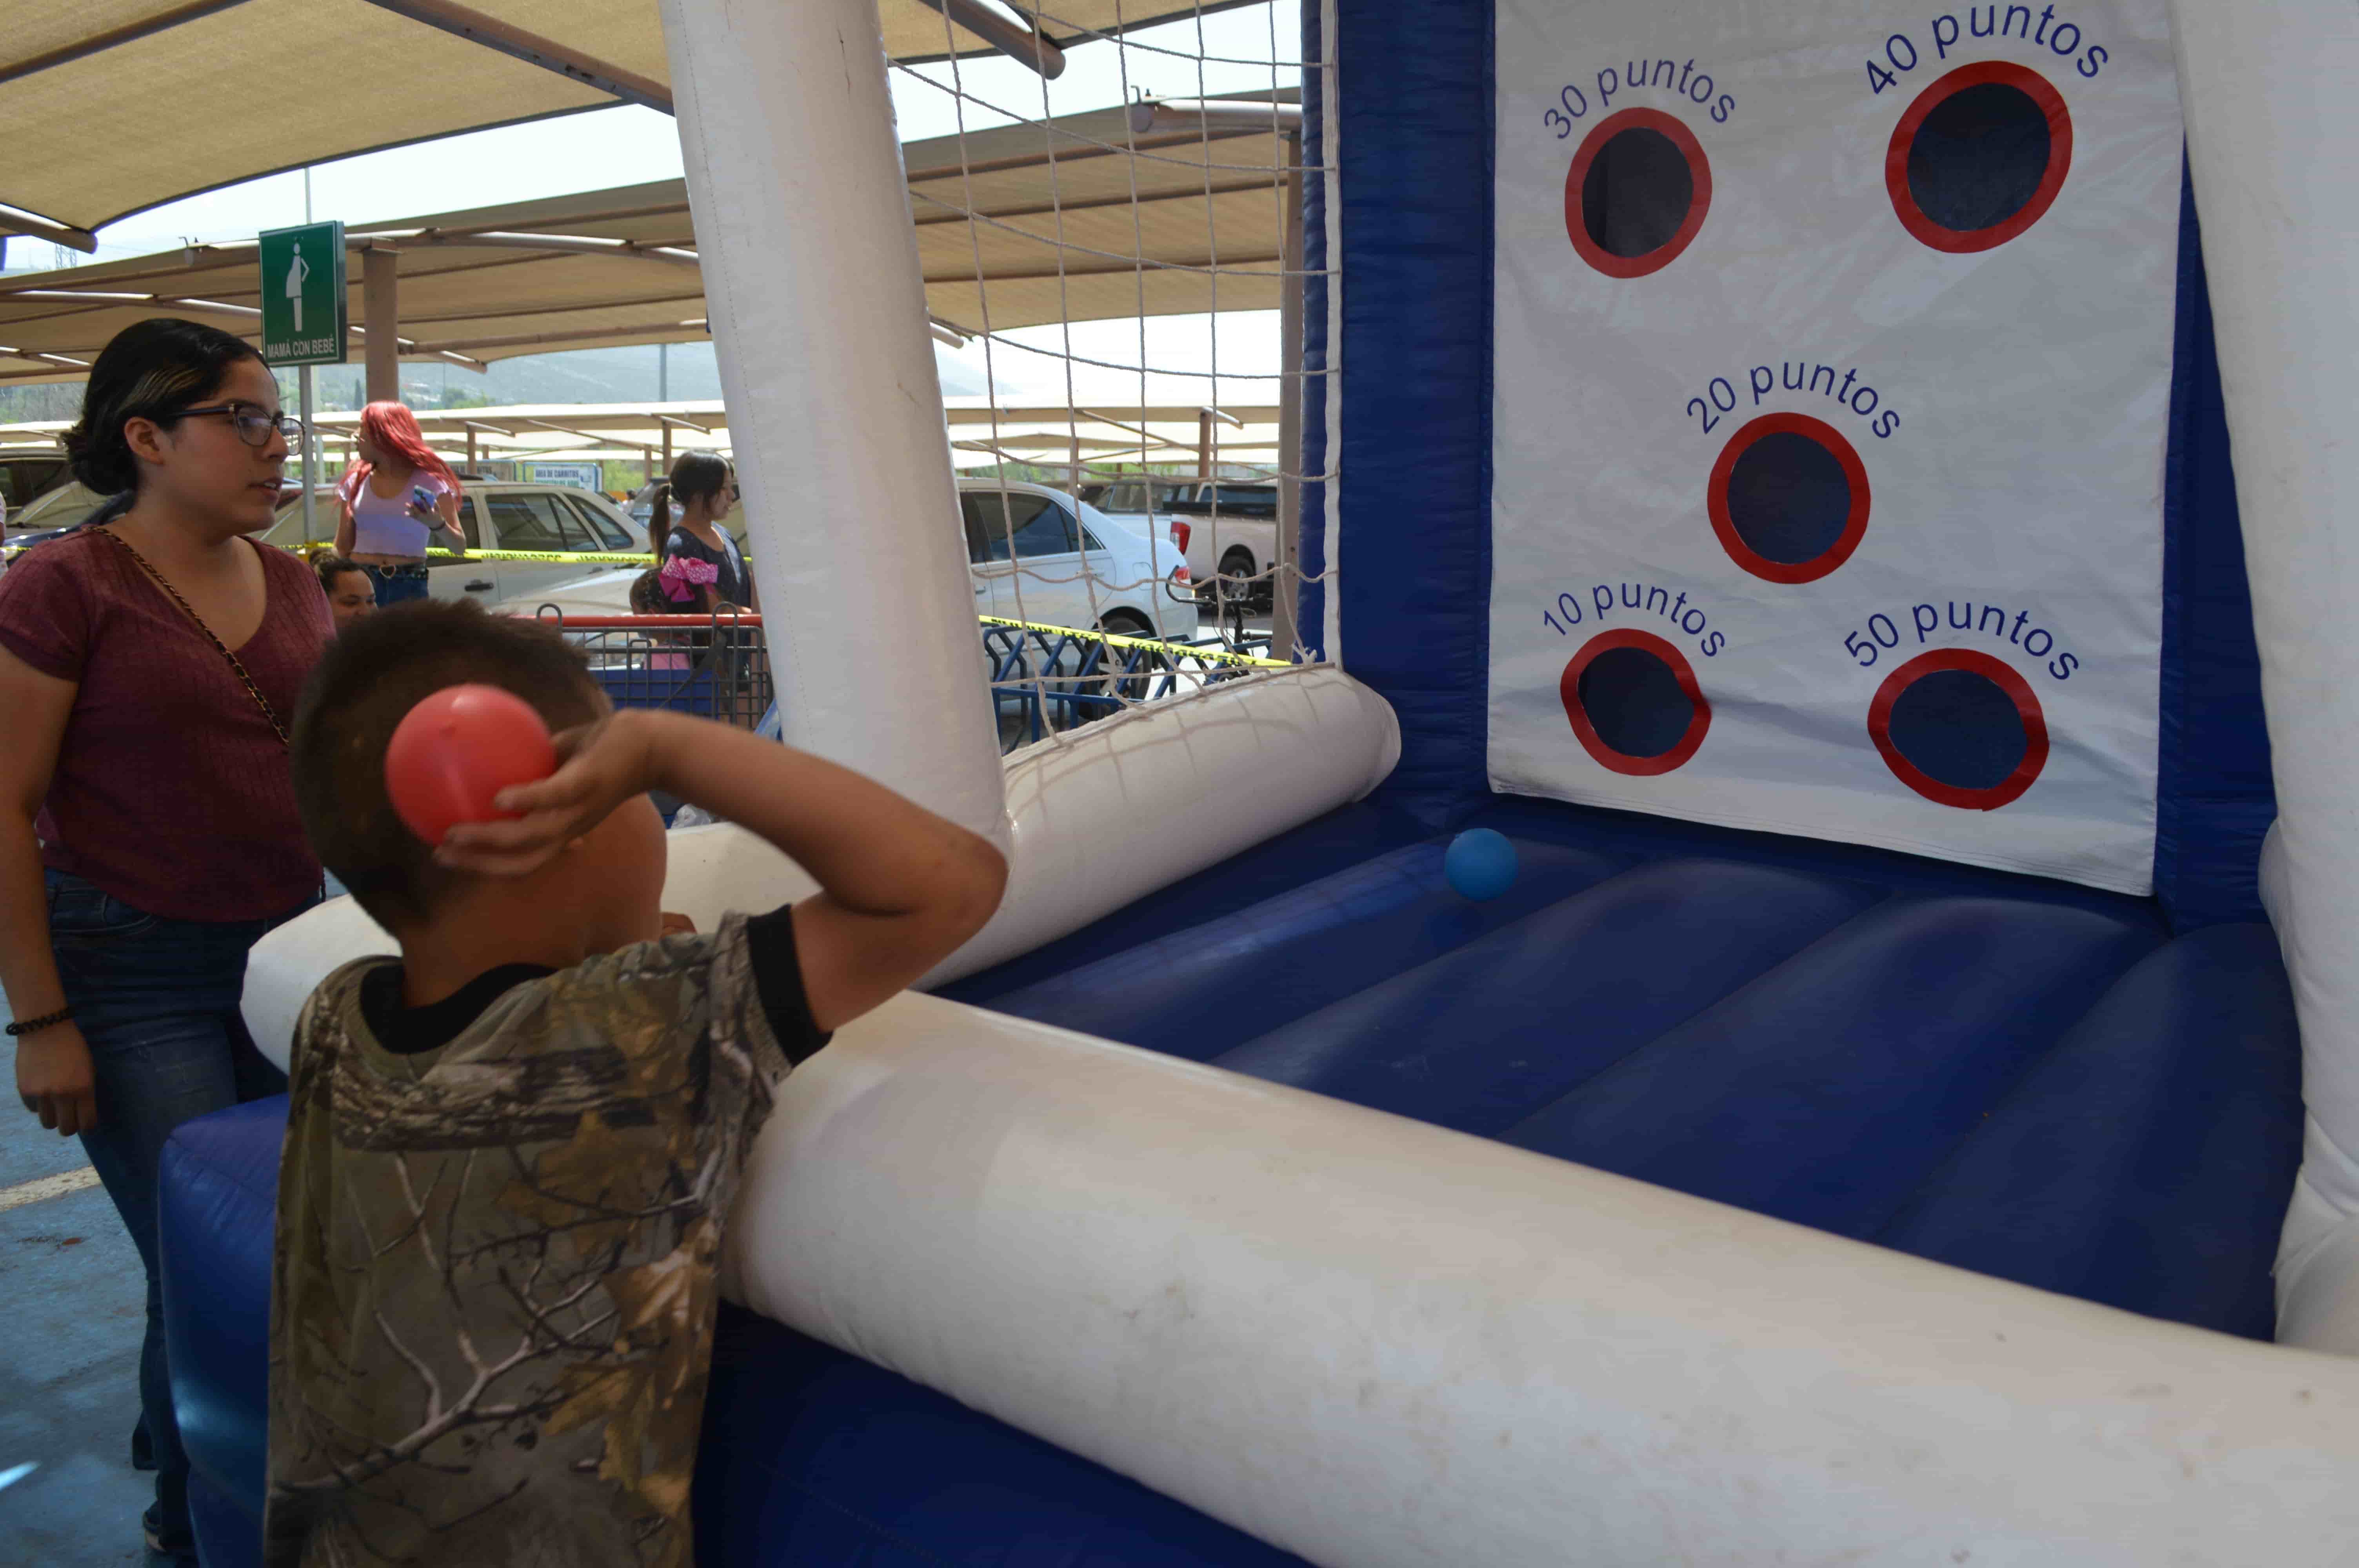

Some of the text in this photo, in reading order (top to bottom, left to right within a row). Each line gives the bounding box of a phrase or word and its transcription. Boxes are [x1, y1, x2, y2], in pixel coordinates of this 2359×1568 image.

[1866, 4, 2108, 94] 40 puntos
[1544, 58, 1736, 139] 30 puntos
[267, 333, 334, 358] MAMÁ CON BEBÉ
[1687, 362, 1900, 439] 20 puntos
[1543, 583, 1725, 657] 10 puntos
[1844, 601, 2079, 680] 50 puntos
